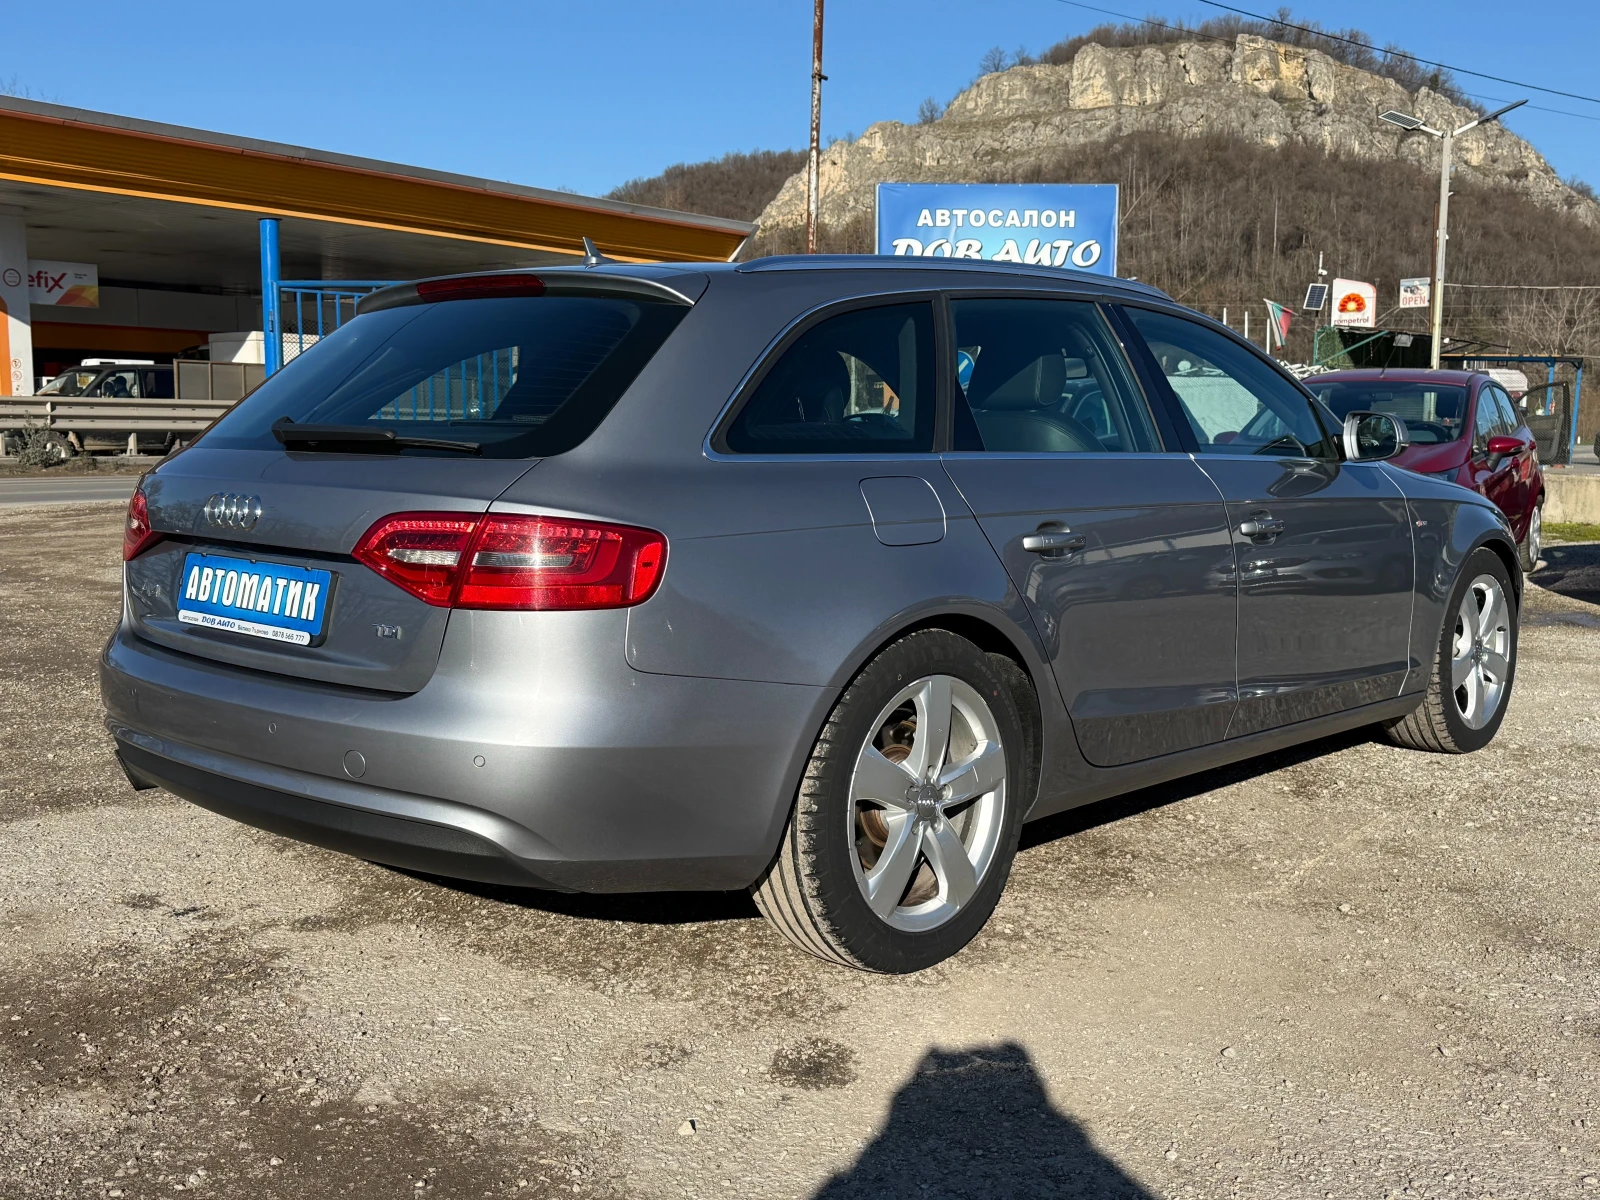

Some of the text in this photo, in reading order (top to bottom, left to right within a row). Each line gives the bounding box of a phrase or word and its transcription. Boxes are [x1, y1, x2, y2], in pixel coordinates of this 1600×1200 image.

[916, 208, 1076, 228] АВТОСАЛОН
[991, 238, 1102, 267] AUTO
[1402, 295, 1426, 306] OPEN
[1334, 316, 1370, 325] rompetrol
[185, 565, 321, 621] АВТОМАТИК
[272, 630, 284, 638] 0878
